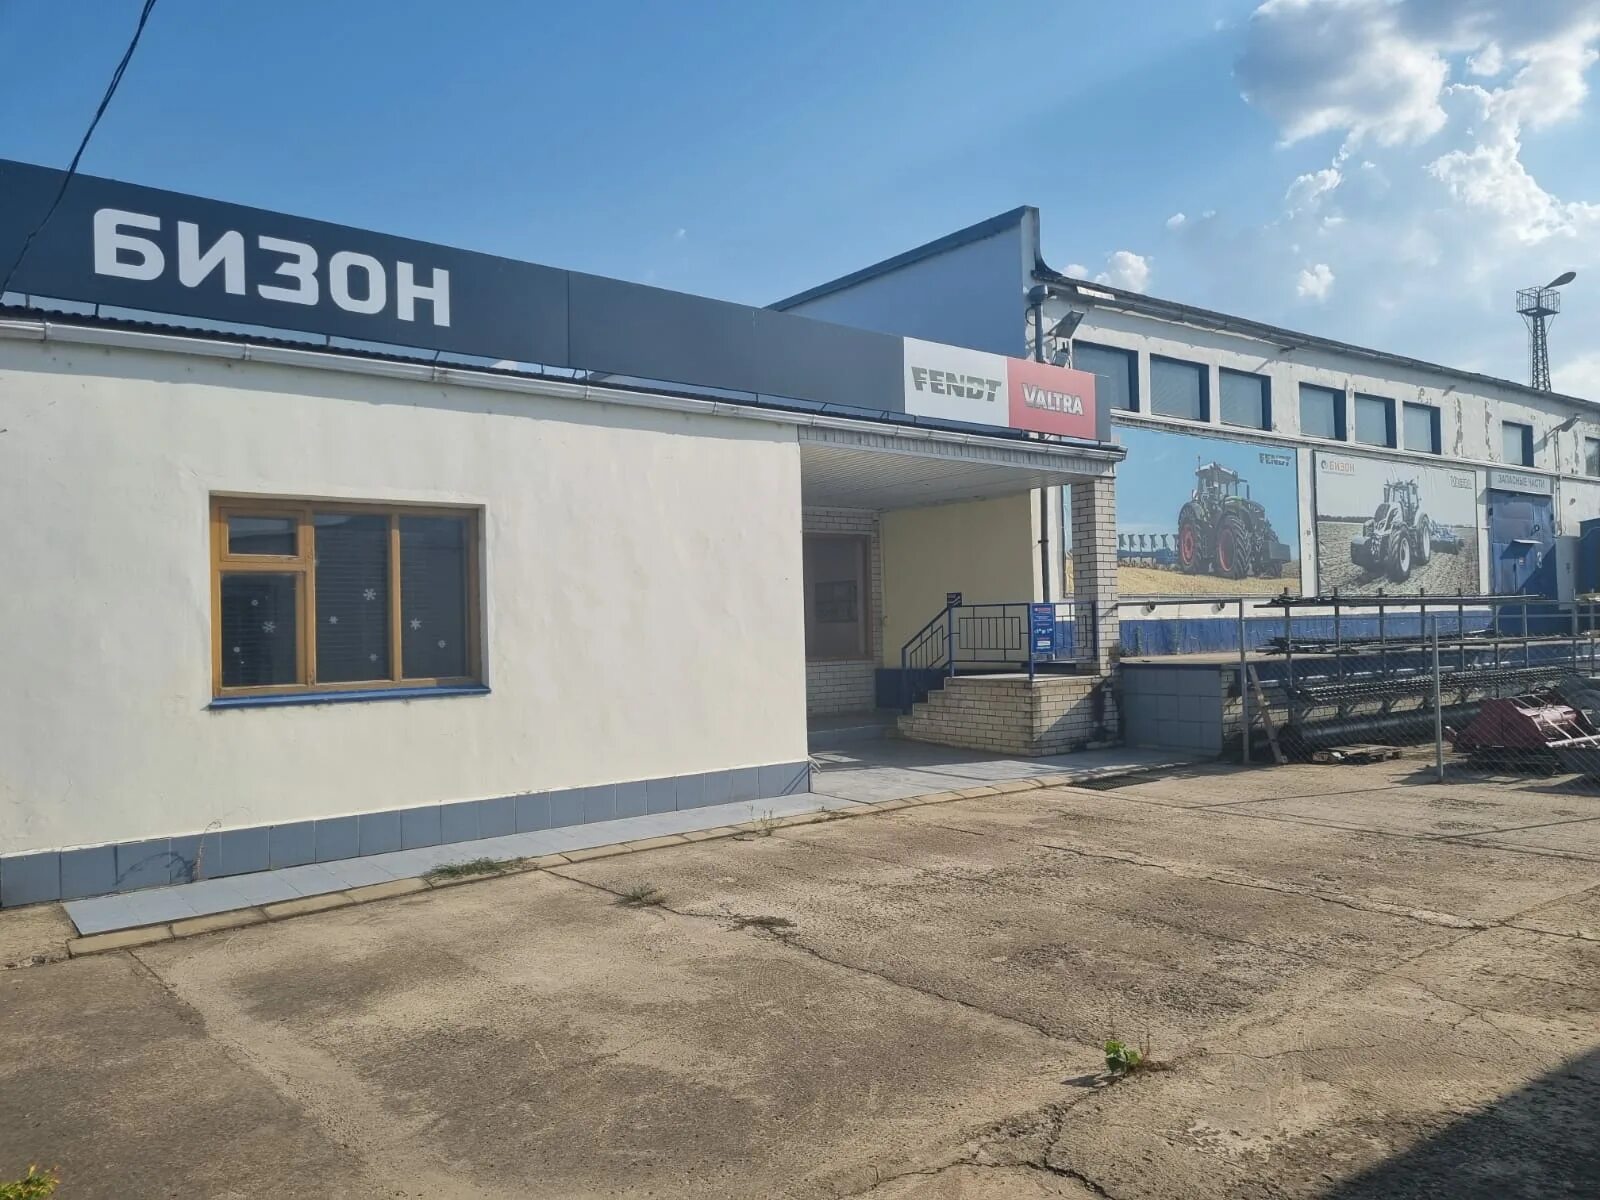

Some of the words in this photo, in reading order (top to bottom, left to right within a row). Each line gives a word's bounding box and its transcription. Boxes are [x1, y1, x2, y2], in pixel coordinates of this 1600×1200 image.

[93, 207, 451, 328] БИЗОН
[911, 366, 1002, 402] FENDT
[1022, 383, 1084, 416] VALTRA
[1259, 453, 1292, 467] FENDT
[1329, 460, 1355, 473] БИЗОН
